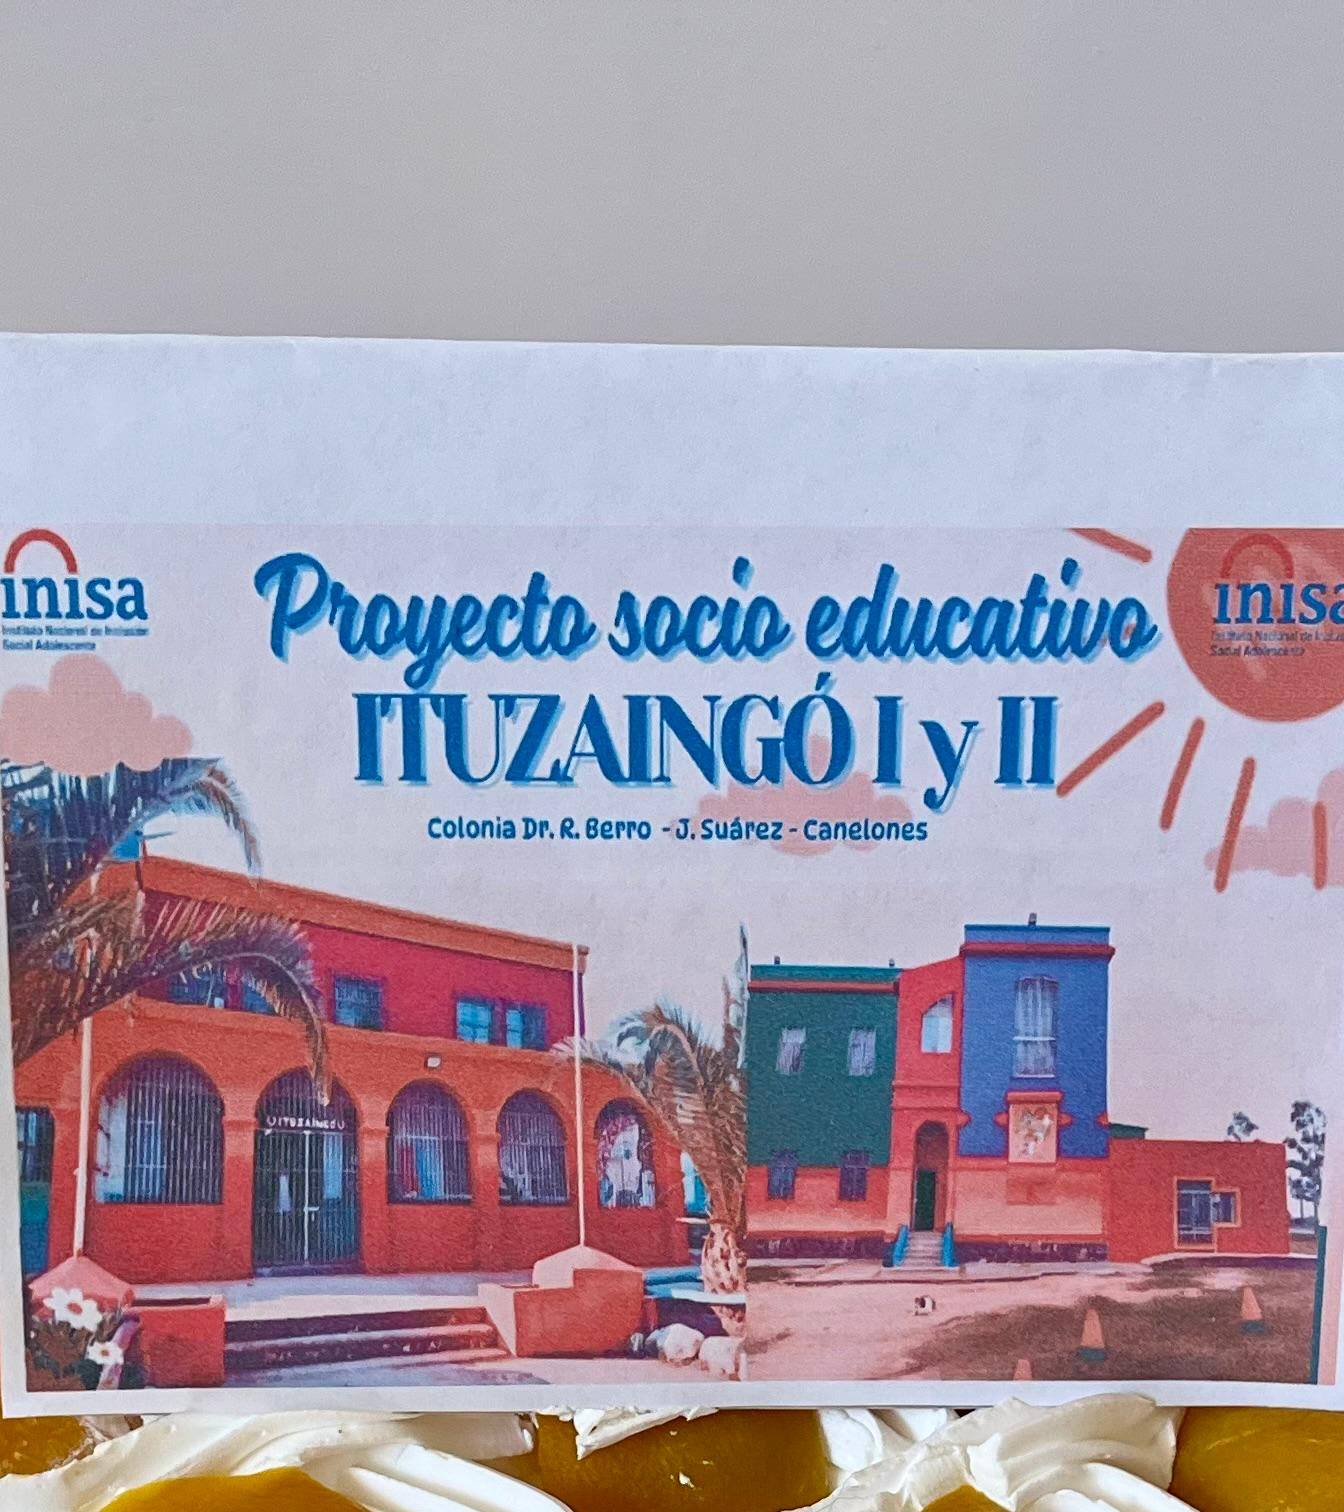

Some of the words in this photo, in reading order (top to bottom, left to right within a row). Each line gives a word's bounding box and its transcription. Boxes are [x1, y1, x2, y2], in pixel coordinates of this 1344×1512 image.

[0, 577, 149, 620] inisa
[253, 551, 598, 692] Proyecto
[607, 556, 793, 663] socio
[805, 557, 1159, 664] educativo
[352, 671, 854, 788] ITUZAINGÓ
[871, 695, 904, 788] I
[918, 719, 980, 813] y
[993, 695, 1059, 788] II
[427, 816, 517, 839] Colonia
[522, 817, 555, 840] Dr.
[560, 817, 580, 840] R.
[585, 817, 652, 840] Berro
[675, 818, 696, 840] J.
[701, 817, 783, 840] Suárez
[803, 818, 928, 840] Canelones
